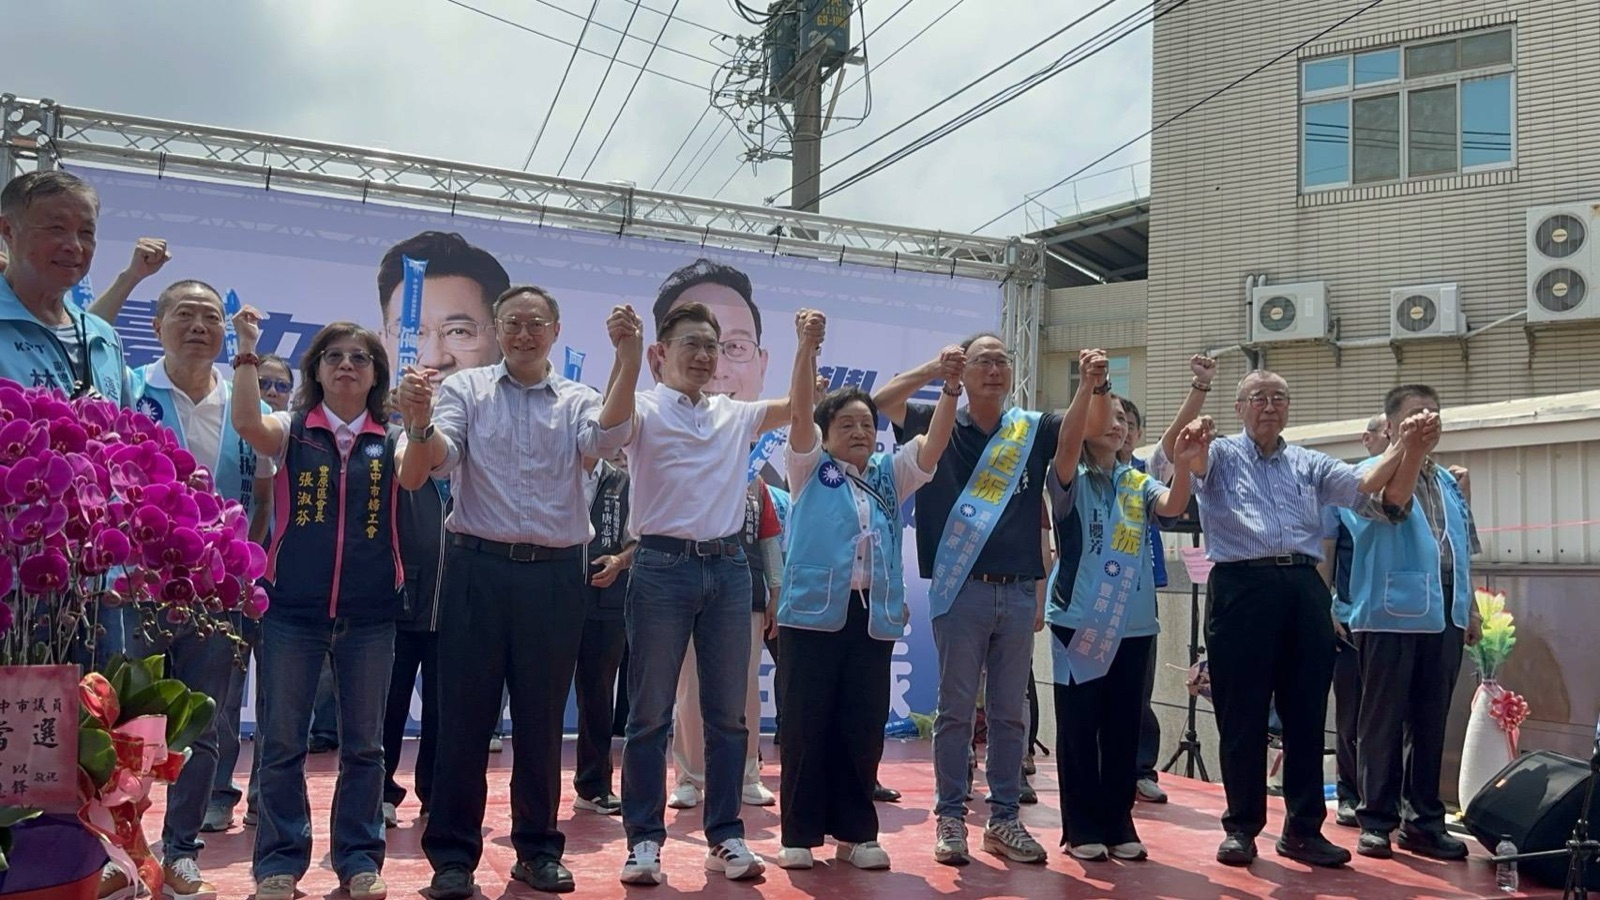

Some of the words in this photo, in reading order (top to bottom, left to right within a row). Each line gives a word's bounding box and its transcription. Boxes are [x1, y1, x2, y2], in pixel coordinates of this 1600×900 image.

[295, 471, 314, 527] 張淑芬
[1094, 566, 1136, 664] 臺中市議員參選人
